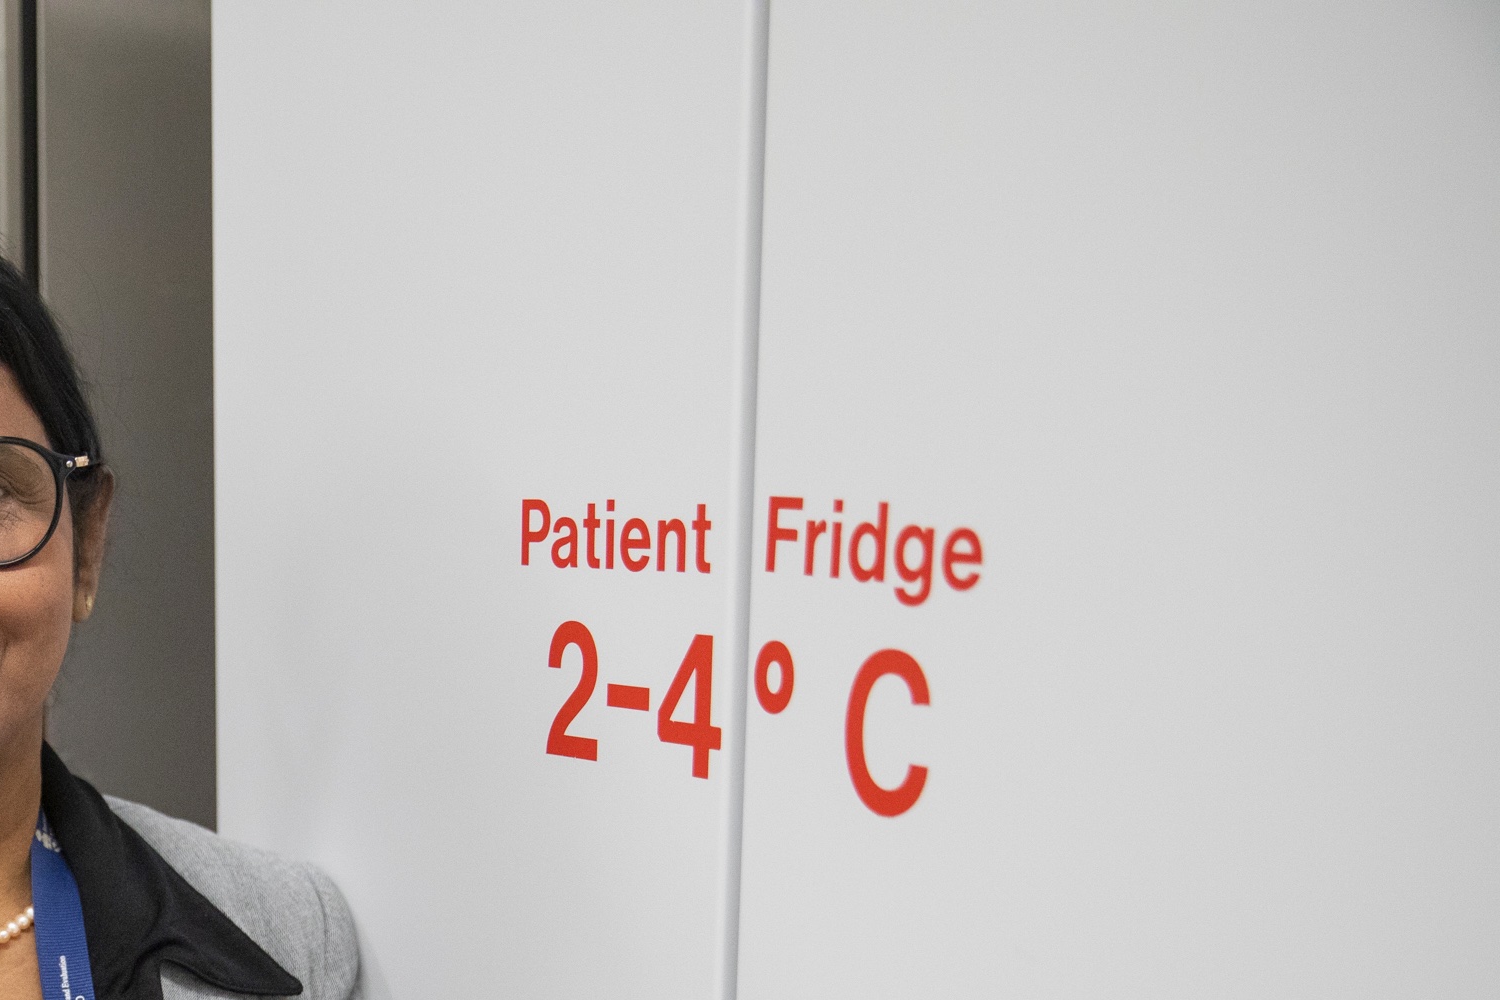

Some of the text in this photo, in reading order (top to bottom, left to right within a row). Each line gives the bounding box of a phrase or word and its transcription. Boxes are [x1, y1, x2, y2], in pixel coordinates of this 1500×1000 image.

[520, 495, 983, 607] Patient Fridge
[844, 648, 931, 818] C
